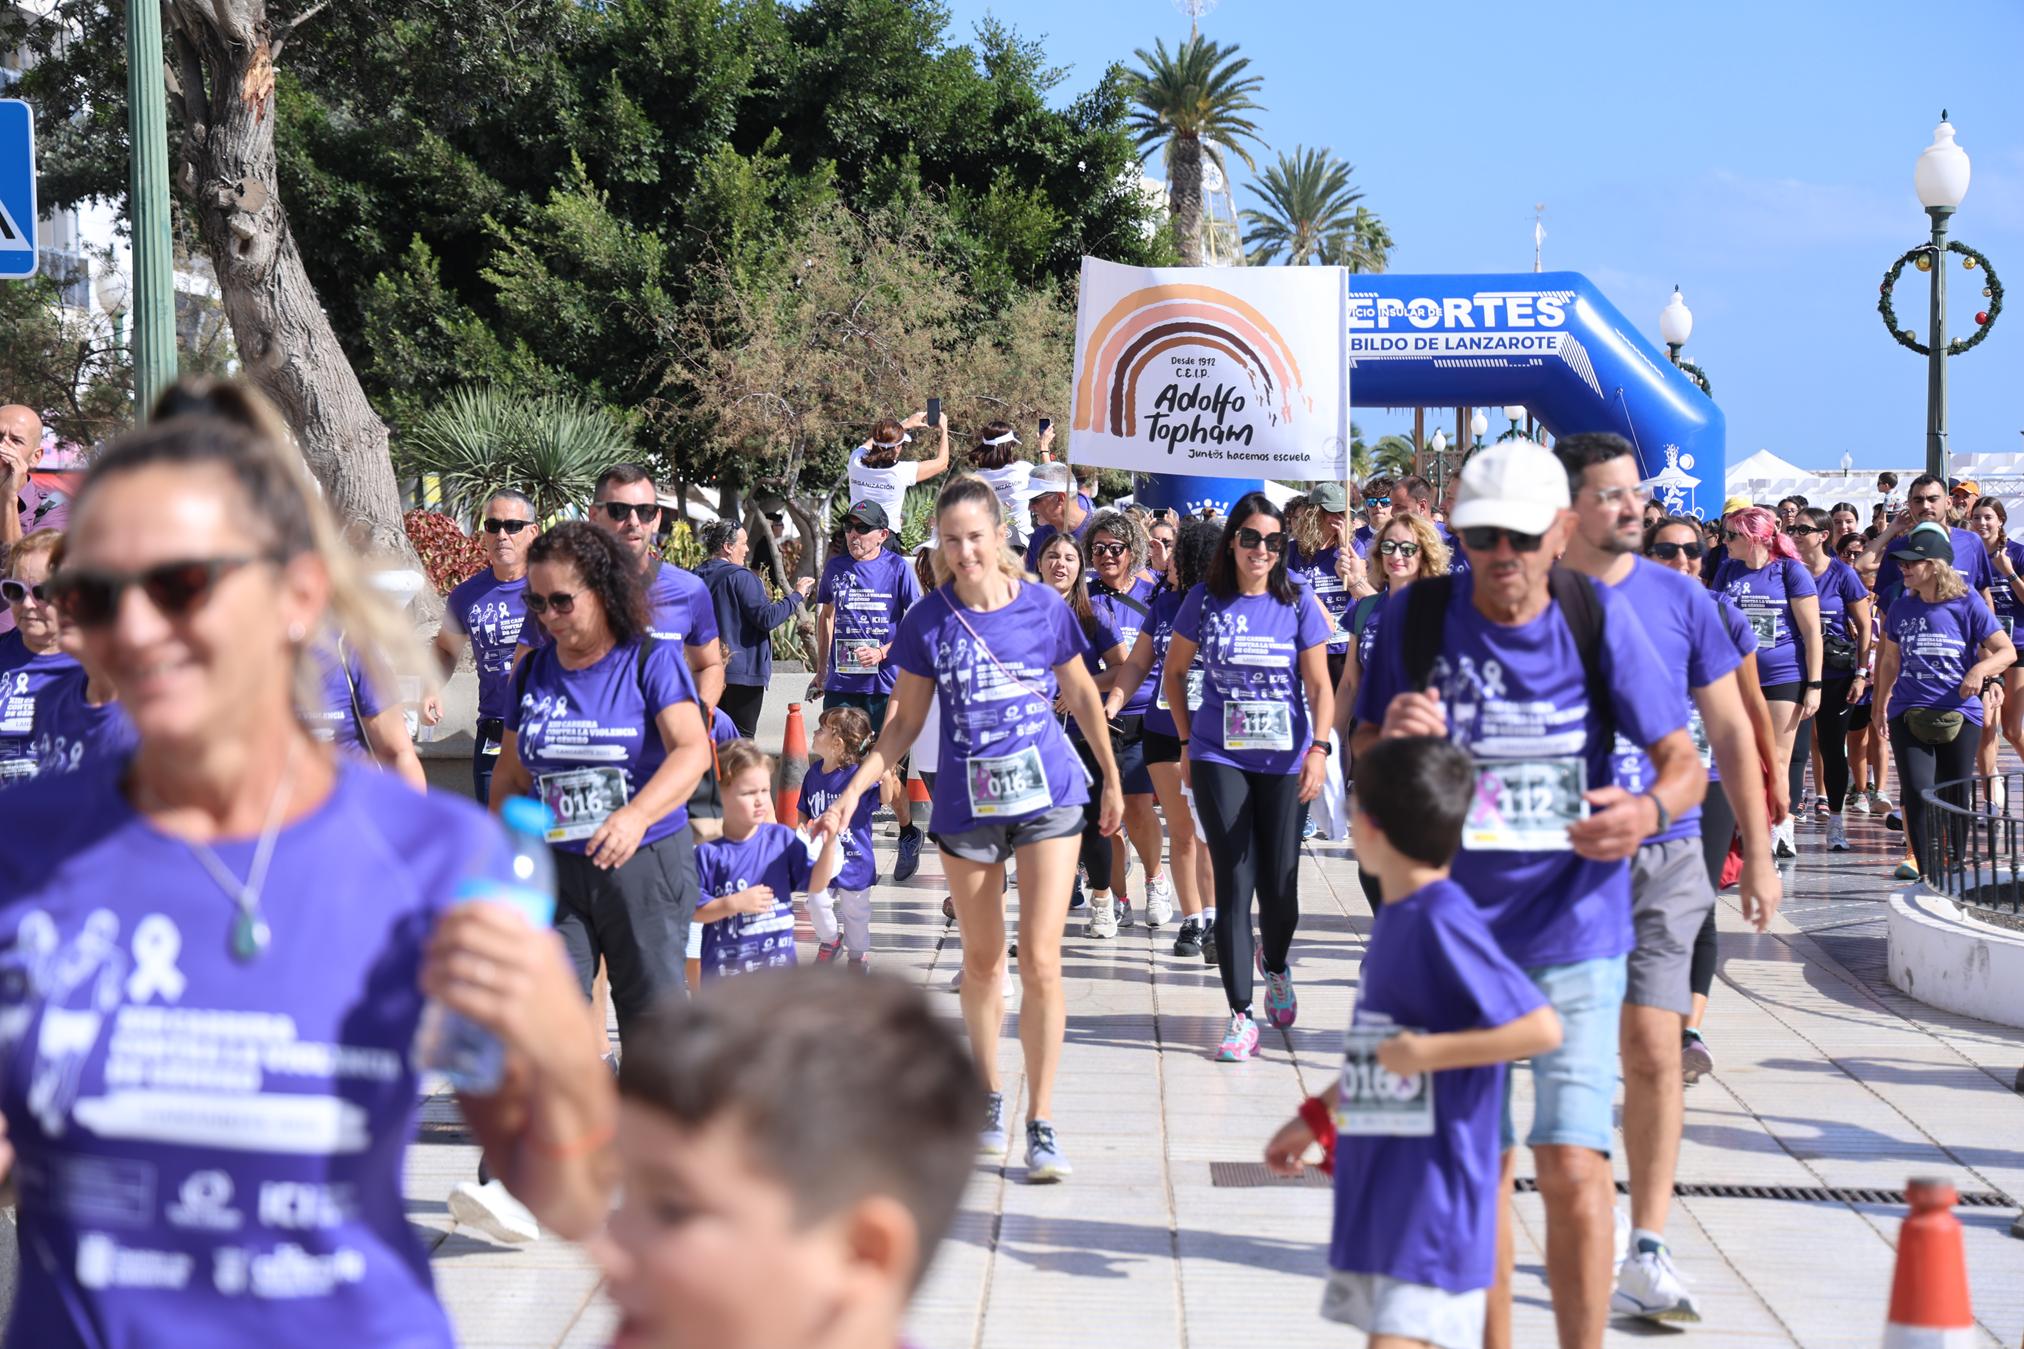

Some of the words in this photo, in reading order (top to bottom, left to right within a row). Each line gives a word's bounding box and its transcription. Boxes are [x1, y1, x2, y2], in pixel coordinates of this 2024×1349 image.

[1378, 308, 1425, 317] INSULAR
[1428, 308, 1443, 317] DE
[1351, 337, 1408, 351] BILDO
[1414, 337, 1439, 350] DE
[1445, 336, 1557, 350] LANZAROTE
[1171, 356, 1195, 365] Desde
[1198, 357, 1216, 367] 1972
[1176, 368, 1210, 379] C.E.I.P.
[1154, 383, 1246, 425] Adolfo
[1144, 412, 1254, 454] Topham
[1226, 450, 1269, 461] hacemos
[1273, 452, 1311, 462] escuela
[1242, 718, 1272, 733] 112
[987, 775, 1027, 797] 016
[559, 790, 604, 818] 016
[1499, 786, 1553, 819] 112
